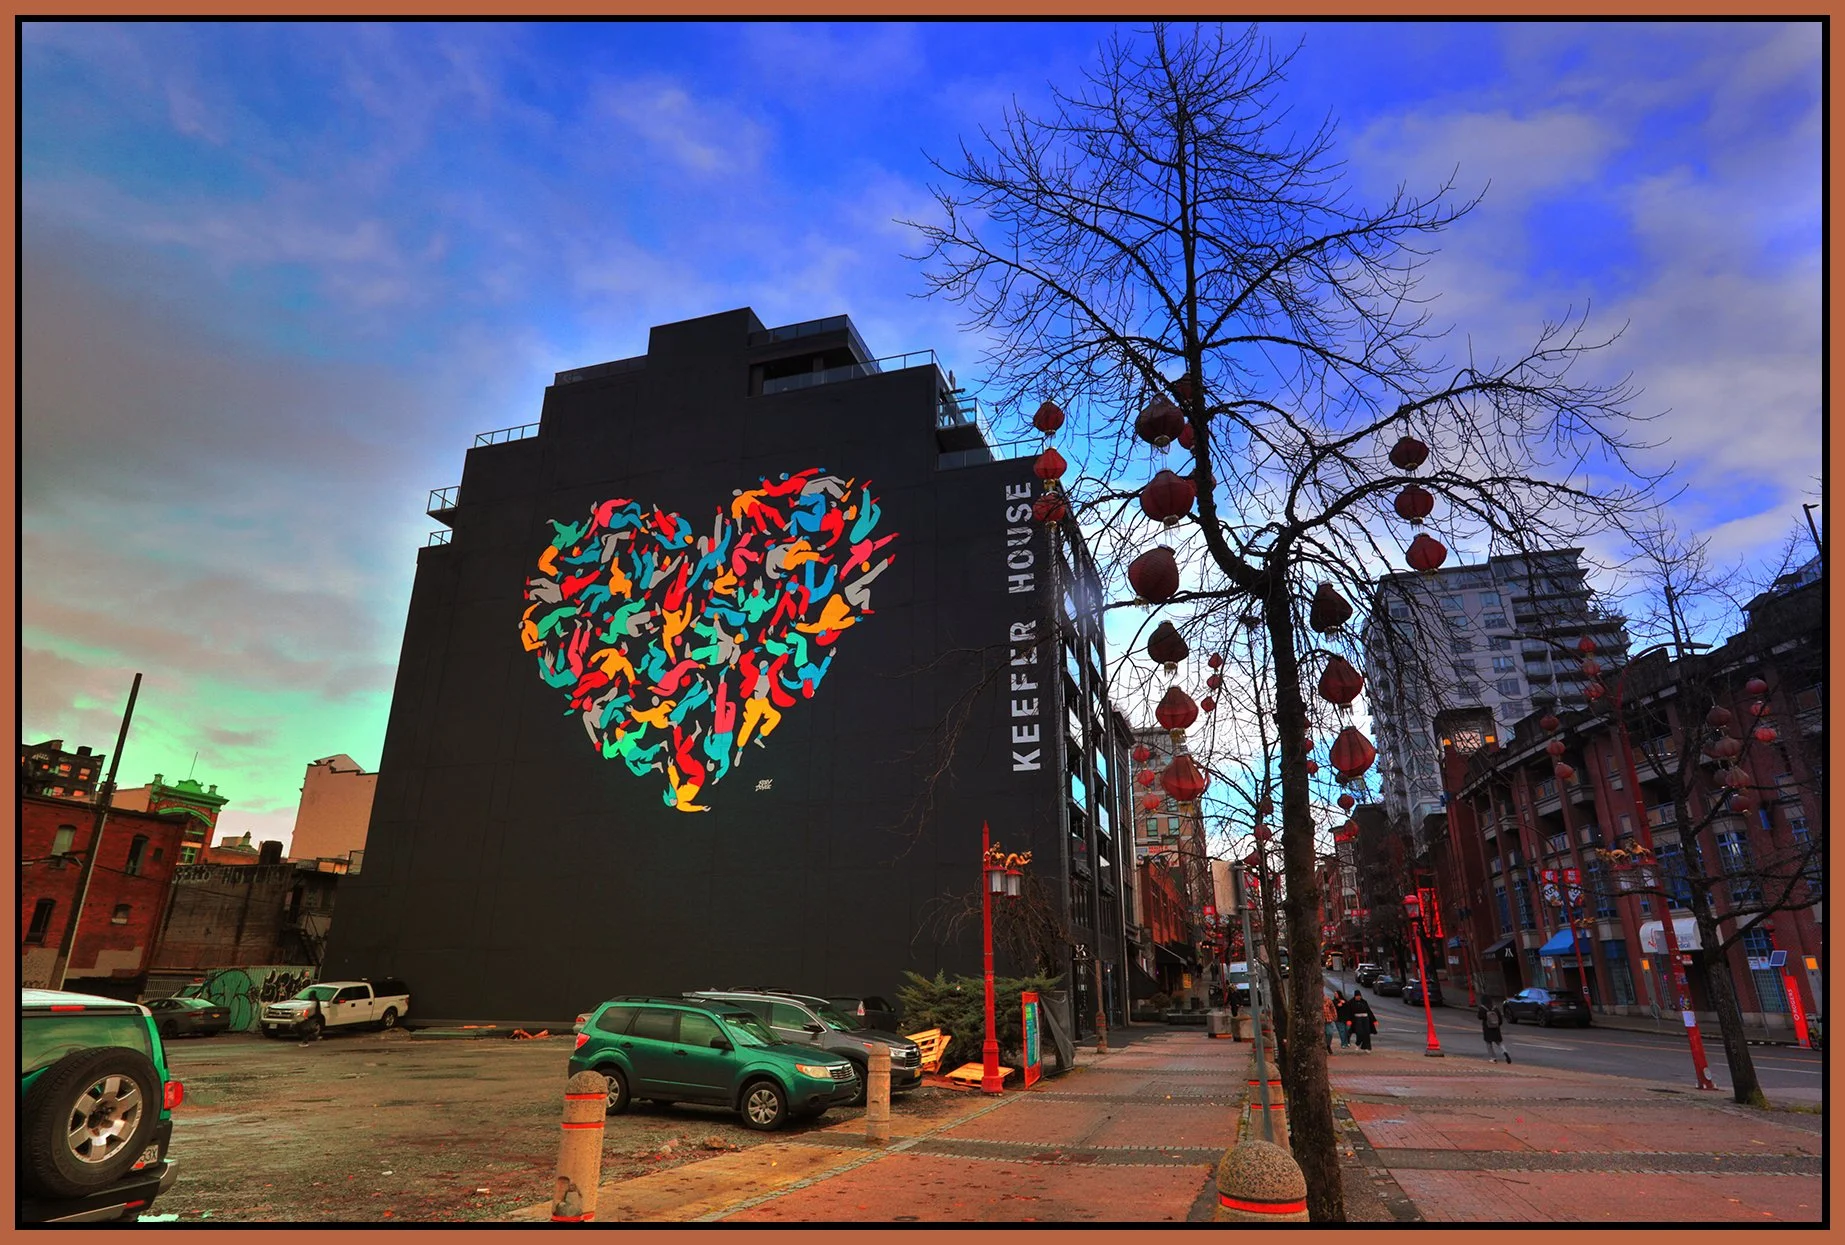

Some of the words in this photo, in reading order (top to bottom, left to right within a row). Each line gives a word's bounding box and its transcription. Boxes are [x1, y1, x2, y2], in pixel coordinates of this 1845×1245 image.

[1005, 482, 1036, 594] HOUSE
[1009, 620, 1041, 772] KEEFER
[1787, 988, 1799, 1015] ROGERS
